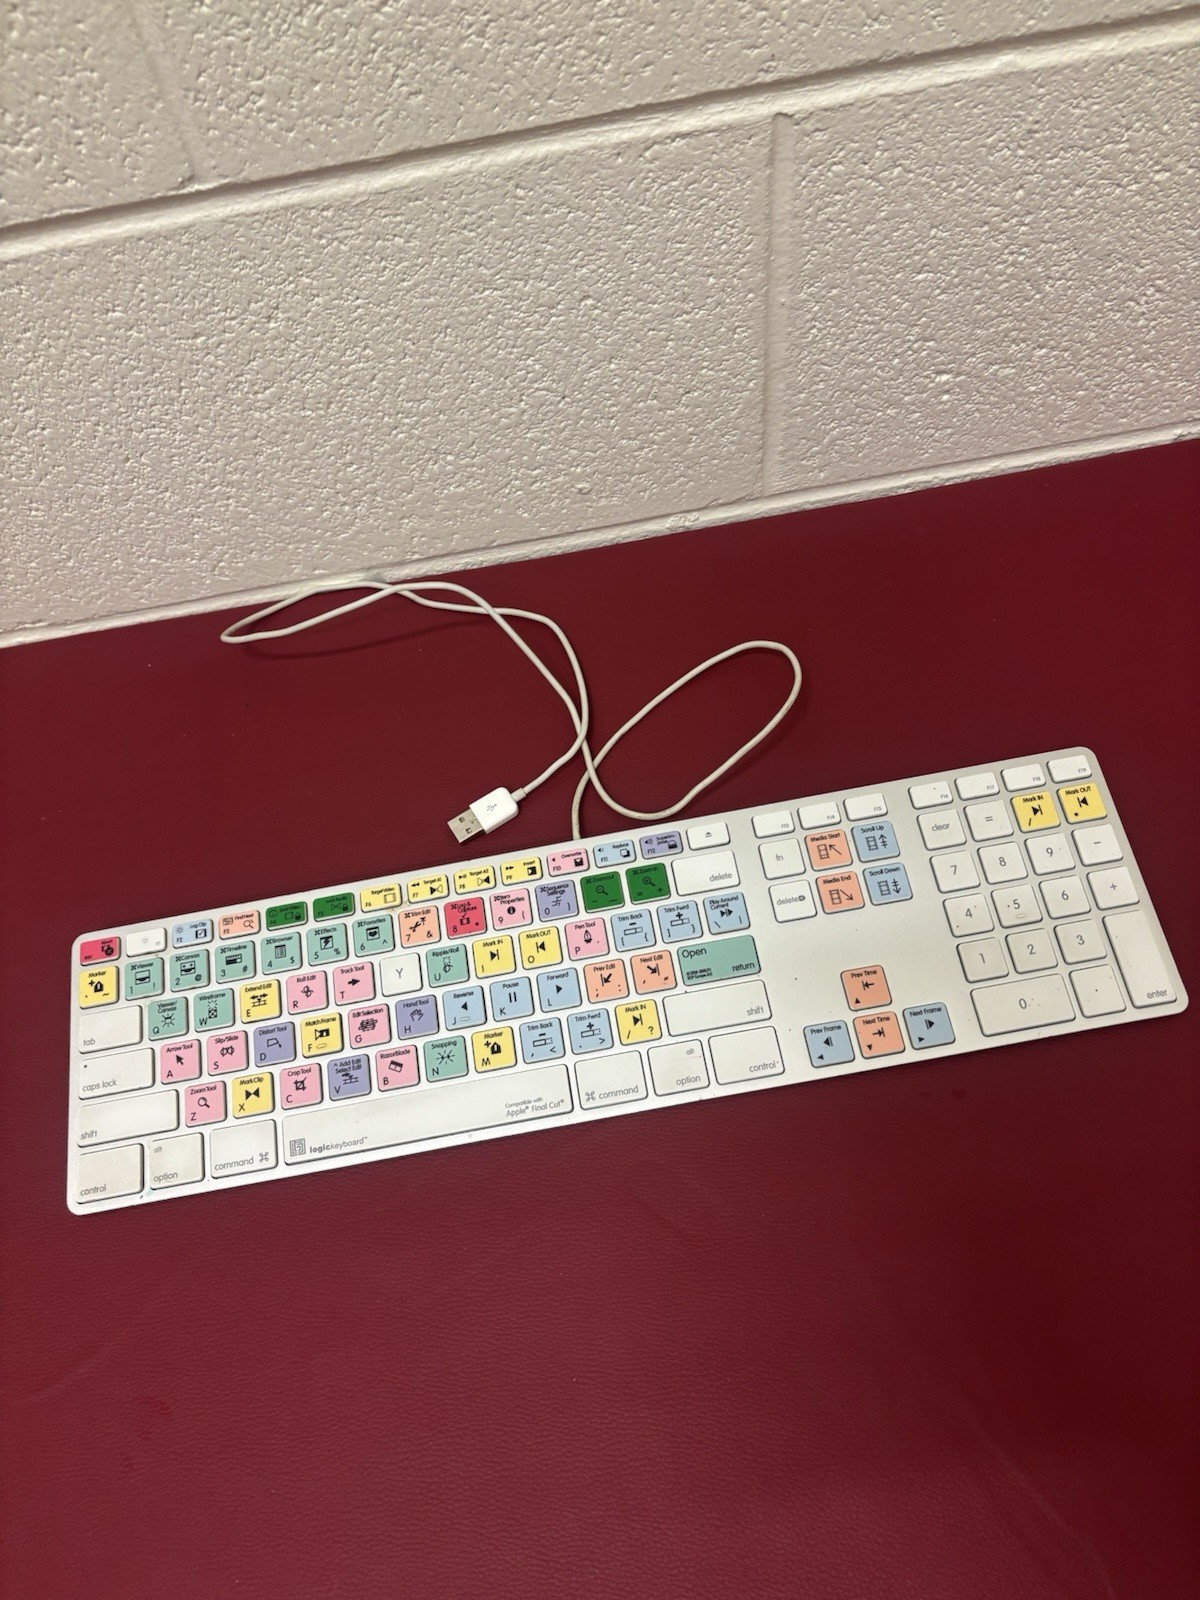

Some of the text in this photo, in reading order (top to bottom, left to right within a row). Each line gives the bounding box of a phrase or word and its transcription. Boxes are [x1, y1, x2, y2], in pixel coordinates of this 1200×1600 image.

[860, 826, 875, 834] Scroll
[931, 823, 950, 832] clear
[810, 834, 826, 842] Media
[1046, 847, 1053, 857] 9
[998, 857, 1006, 867] 8
[884, 866, 901, 874] Down
[950, 865, 957, 875] 7
[709, 873, 732, 882] delete
[823, 877, 840, 885] Media
[1061, 890, 1069, 900] 6
[776, 896, 798, 905] delete
[1013, 899, 1020, 909] 5
[965, 908, 973, 918] 4
[498, 916, 504, 924] 9
[405, 934, 411, 942] 7
[526, 931, 539, 939] Mark
[1076, 934, 1085, 945] 3
[360, 943, 365, 951] 6
[482, 940, 496, 948] Mark
[575, 946, 581, 955] P
[681, 948, 707, 959] Open
[1026, 944, 1036, 954] 2
[314, 951, 319, 960] 5
[979, 953, 986, 963] 1
[267, 960, 273, 968] 4
[732, 961, 755, 972] return
[88, 970, 107, 978] Marker
[220, 969, 226, 977] 3
[341, 966, 354, 975] Track
[395, 968, 403, 979] Y
[850, 969, 878, 979] Prev Time
[175, 977, 181, 985] 2
[434, 973, 441, 981] U
[546, 972, 569, 981] Forward
[130, 986, 133, 994] 1
[453, 990, 474, 999] Reverse
[1147, 989, 1168, 1000] enter
[199, 992, 226, 1001] Wireframe
[340, 991, 345, 999] T
[293, 1000, 299, 1008] R
[403, 1001, 418, 1009] Hand
[547, 998, 553, 1007] L
[1018, 998, 1027, 1009] 0
[157, 1006, 177, 1014] Canvas
[246, 1009, 251, 1017] E
[361, 1008, 384, 1016] Selection
[499, 1007, 506, 1015] K
[625, 1005, 638, 1013] Mark
[746, 1006, 764, 1016] shift
[924, 1006, 942, 1014] Frame
[587, 1012, 601, 1020] Fwrd
[199, 1017, 208, 1026] W
[452, 1017, 457, 1025] J
[862, 1018, 876, 1026] Next
[152, 1026, 160, 1034] Q
[259, 1027, 276, 1036] Distort
[404, 1025, 411, 1034] H
[810, 1024, 842, 1035] Prev Frame
[355, 1035, 362, 1043] G
[484, 1031, 503, 1039] Marker
[83, 1038, 96, 1046] tab
[431, 1040, 458, 1050] Snapping
[308, 1043, 313, 1052] F
[260, 1053, 266, 1061] D
[481, 1057, 491, 1066] M
[213, 1061, 219, 1069] S
[749, 1061, 777, 1073] control
[166, 1070, 174, 1078] A
[432, 1067, 439, 1076] N
[82, 1078, 117, 1092] caps lock
[239, 1078, 254, 1086] Mark
[383, 1077, 389, 1085] B
[676, 1075, 701, 1087] option
[190, 1087, 206, 1095] Zoom
[334, 1085, 341, 1094] V
[598, 1085, 639, 1100] command
[286, 1094, 293, 1103] C
[238, 1103, 245, 1112] X
[505, 1099, 532, 1109] Compatible
[532, 1102, 547, 1112] Final
[190, 1112, 197, 1121] Z
[80, 1130, 98, 1140] shift
[214, 1156, 254, 1171] command
[154, 1172, 178, 1183] option
[80, 1184, 107, 1197] control
